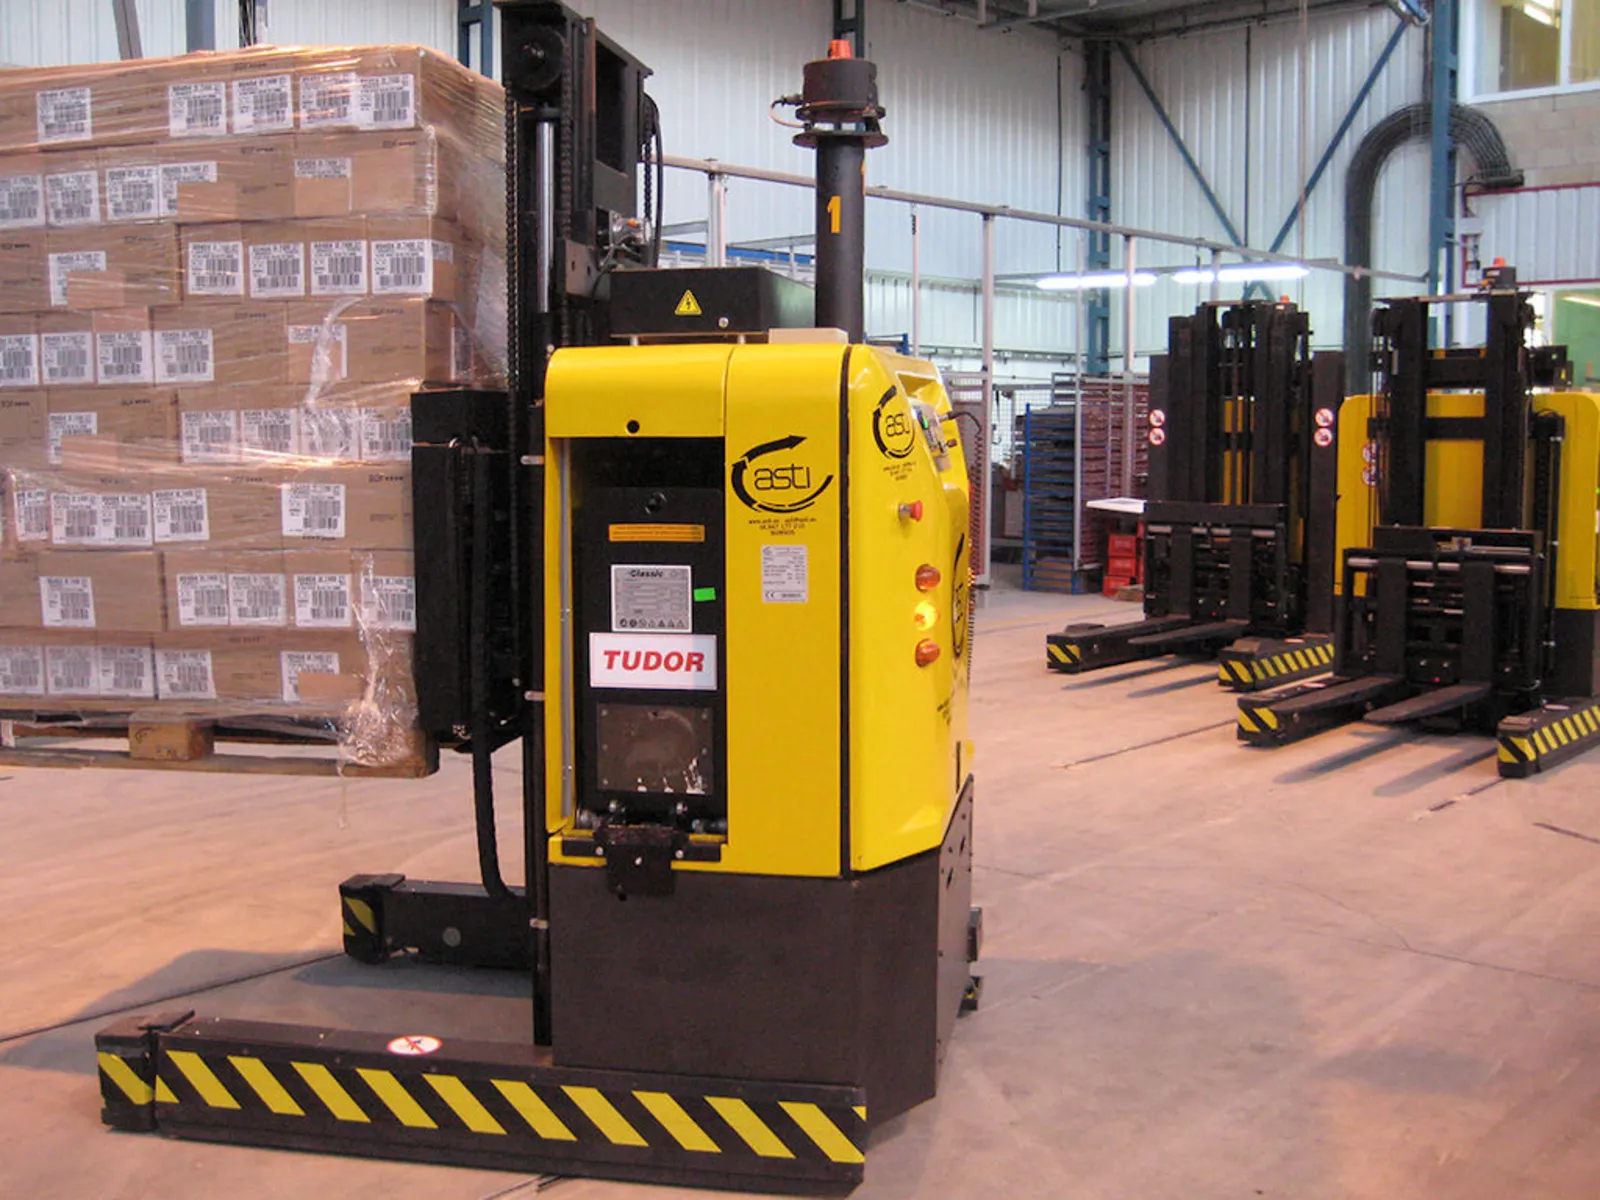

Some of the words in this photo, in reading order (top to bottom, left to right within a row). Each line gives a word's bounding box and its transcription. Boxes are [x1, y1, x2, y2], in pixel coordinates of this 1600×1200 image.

[827, 195, 841, 234] 1
[754, 464, 811, 490] asti
[630, 569, 664, 578] Classic
[603, 650, 705, 673] TUDOR
